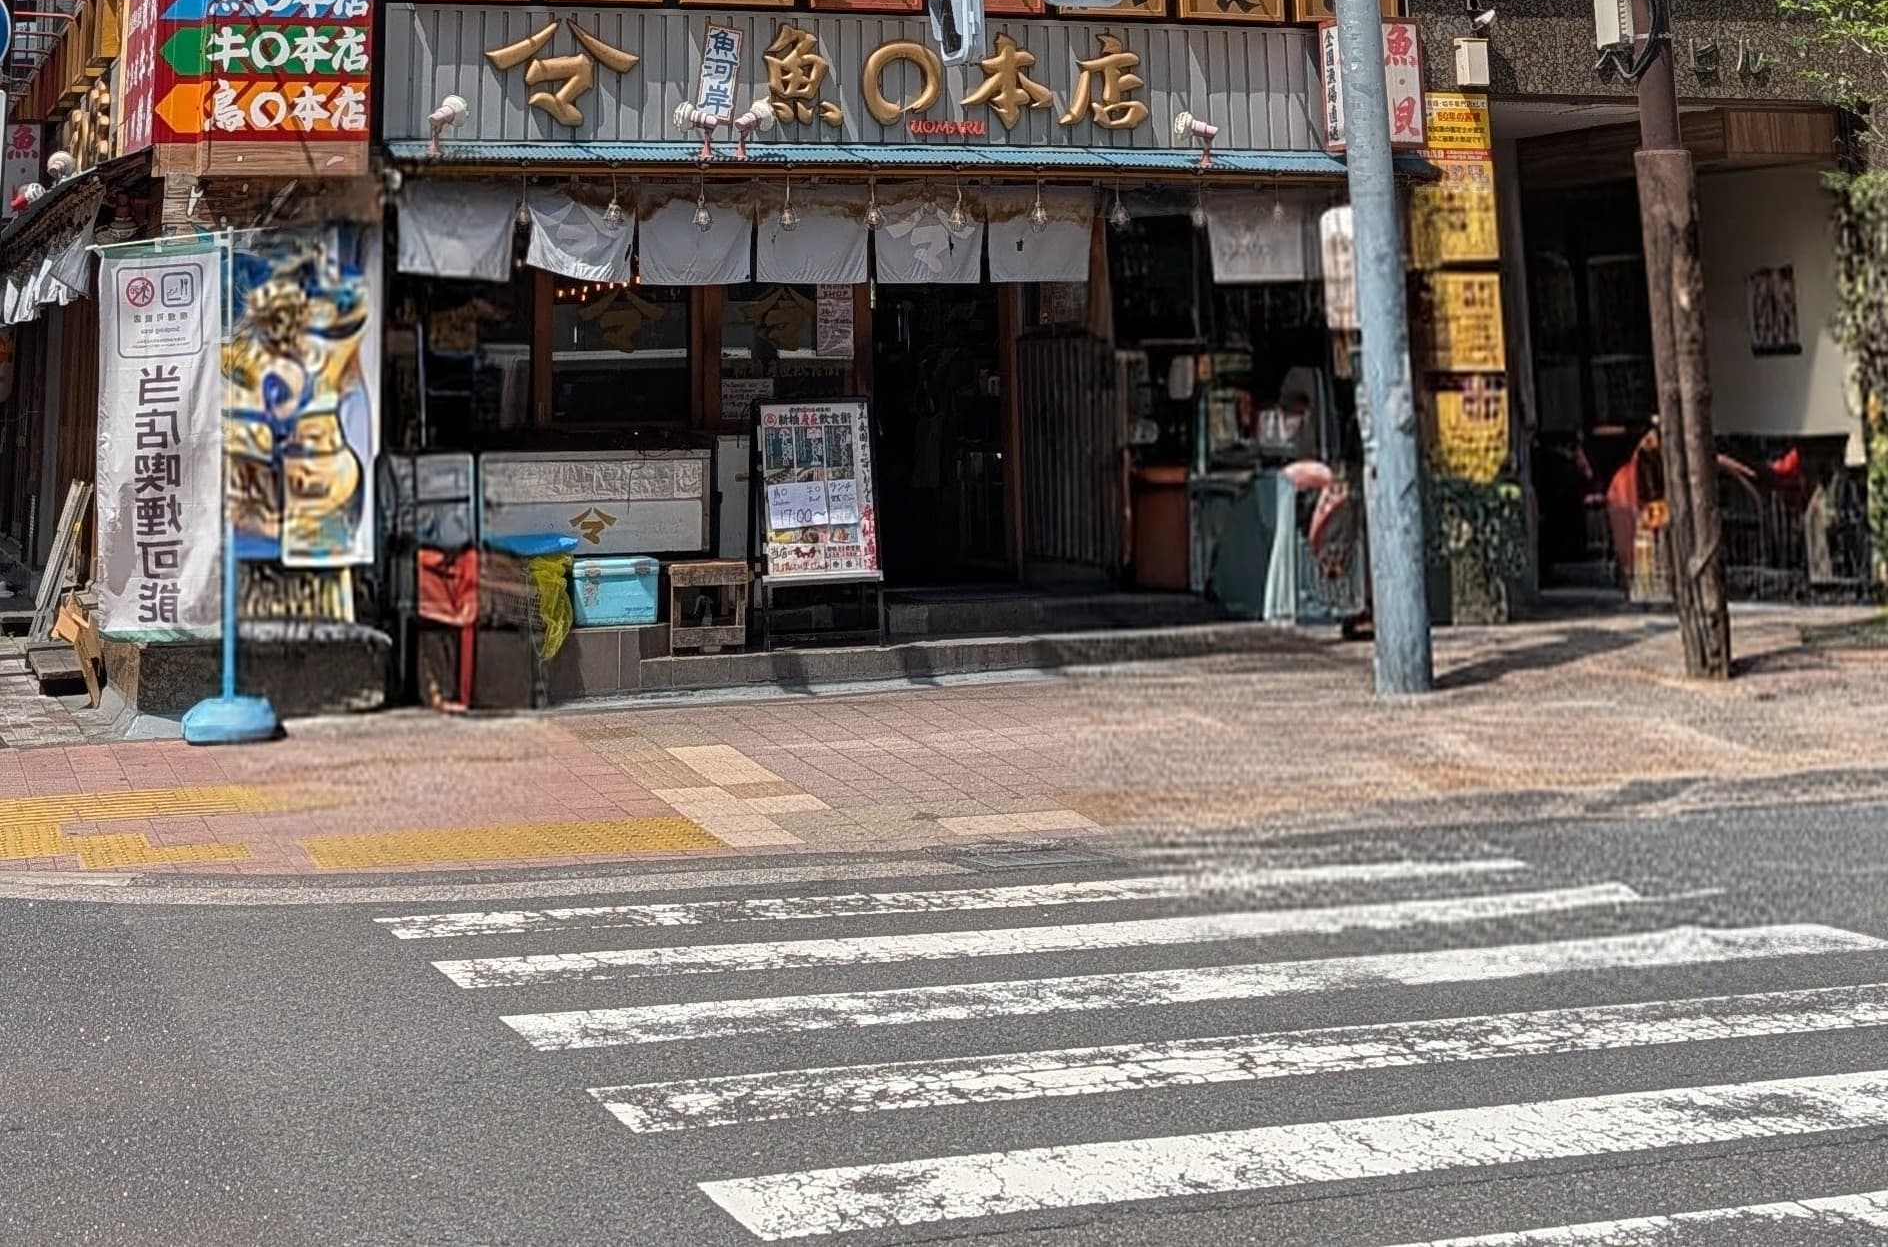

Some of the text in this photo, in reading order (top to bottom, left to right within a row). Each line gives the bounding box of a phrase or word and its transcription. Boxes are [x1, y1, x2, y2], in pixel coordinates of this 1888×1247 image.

[698, 29, 739, 115] 魚河岸
[911, 120, 985, 136] UOMARU
